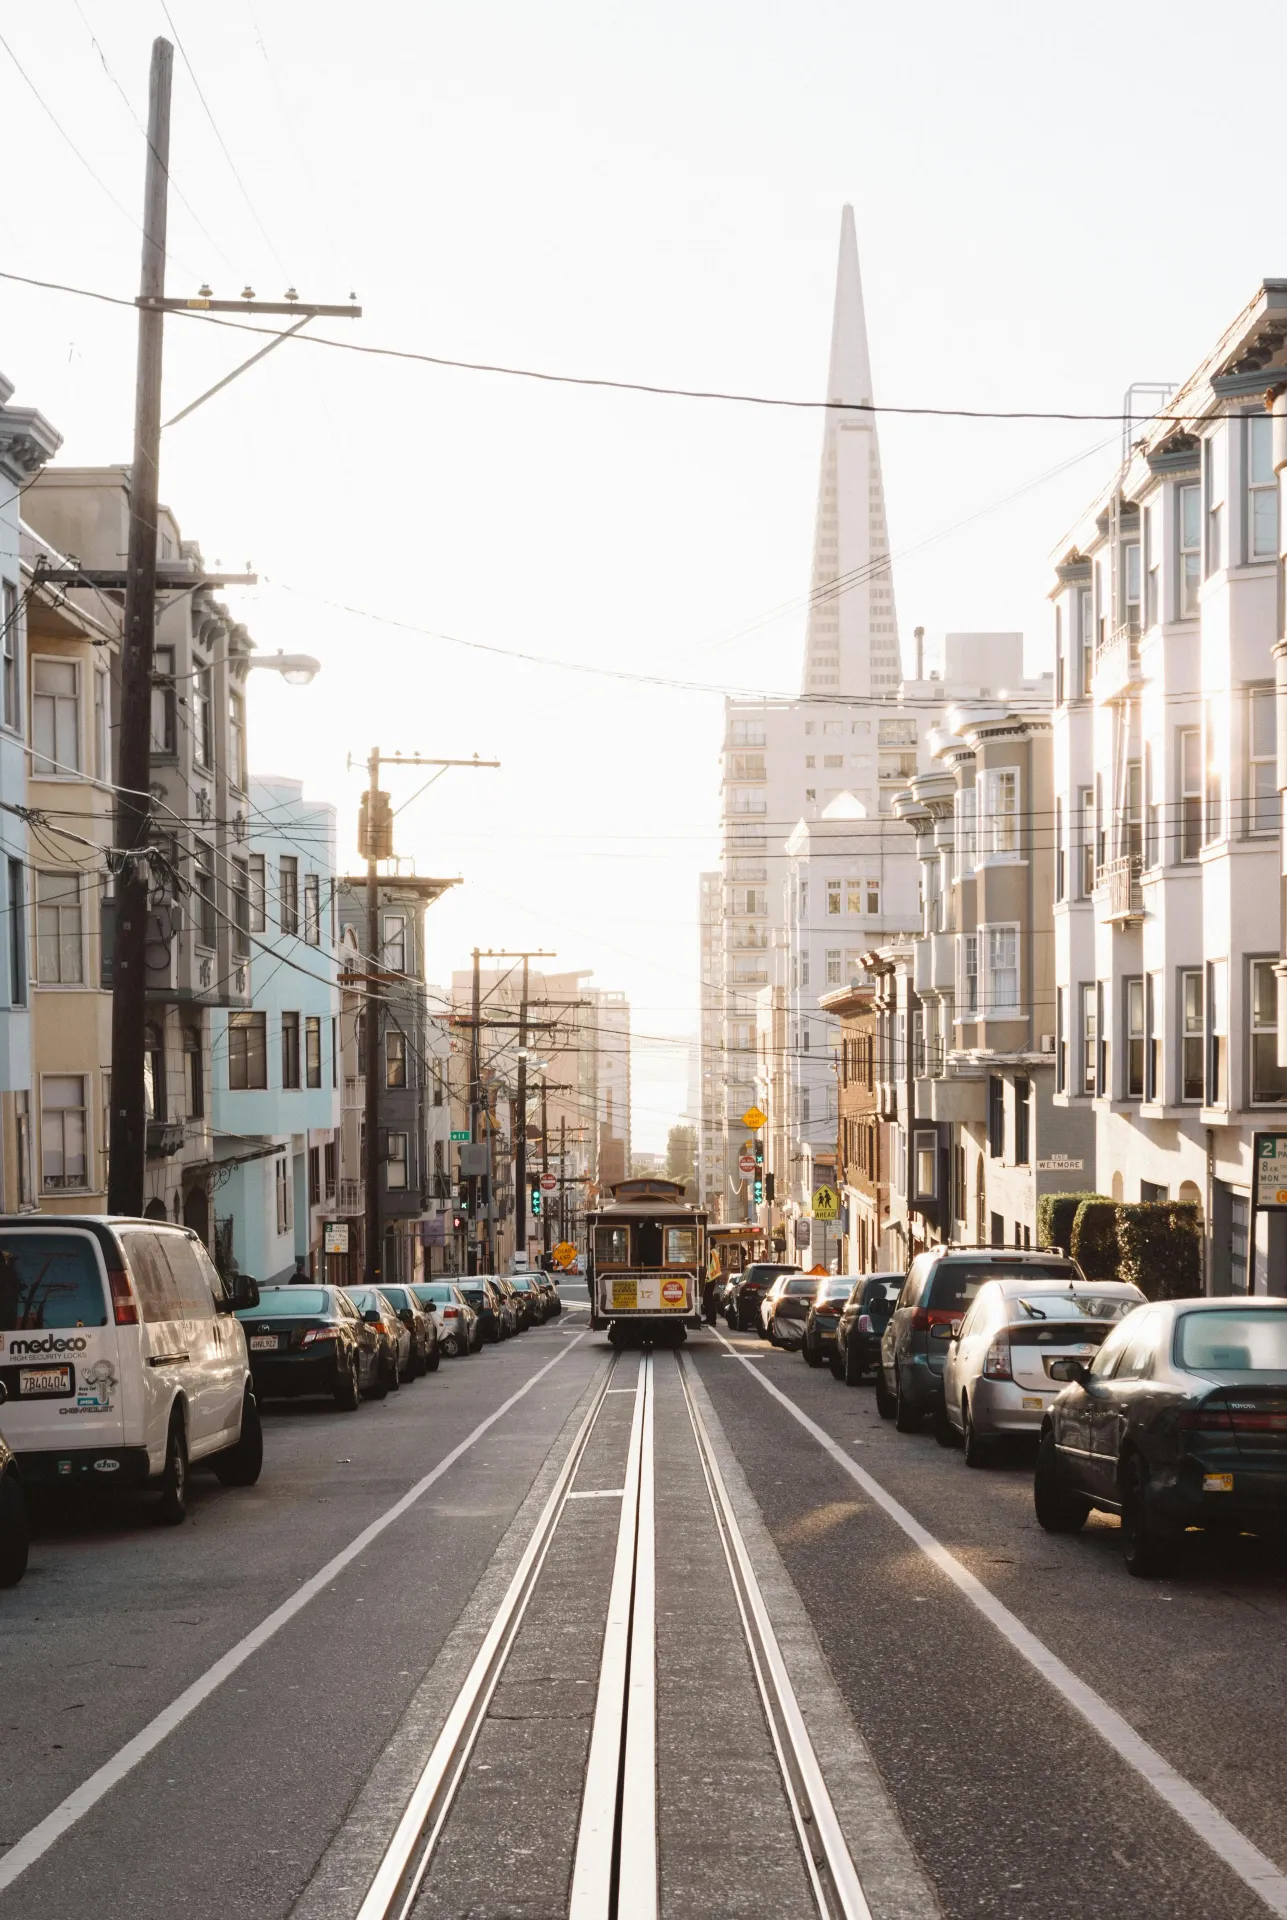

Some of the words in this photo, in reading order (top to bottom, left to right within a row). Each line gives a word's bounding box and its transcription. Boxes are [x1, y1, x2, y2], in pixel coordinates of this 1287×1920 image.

[1263, 1142, 1272, 1156] 2
[1262, 1161, 1268, 1171] 8
[640, 1290, 654, 1299] 17
[10, 1334, 86, 1354] medeco
[23, 1376, 66, 1390] 7B40404
[59, 1406, 114, 1414] CHEVROLET
